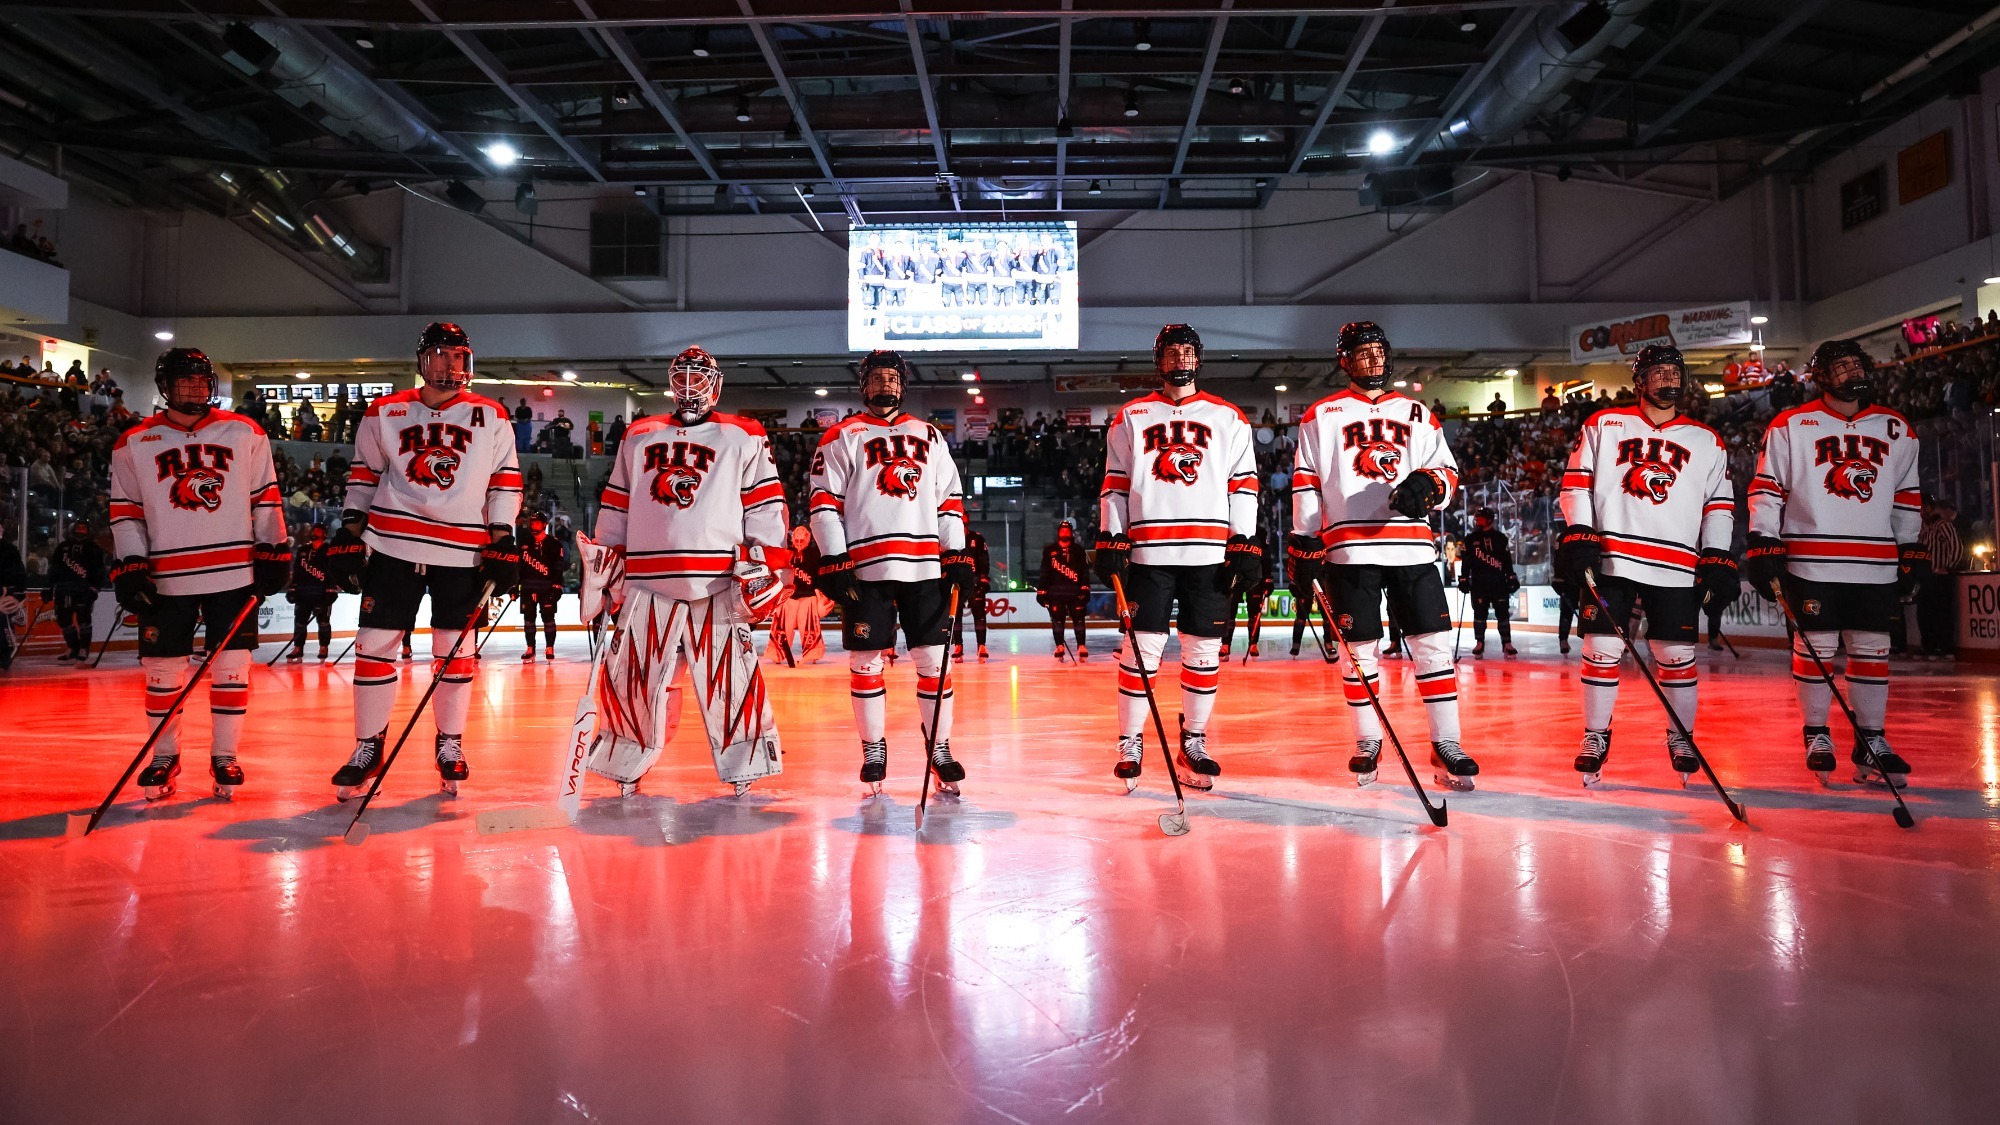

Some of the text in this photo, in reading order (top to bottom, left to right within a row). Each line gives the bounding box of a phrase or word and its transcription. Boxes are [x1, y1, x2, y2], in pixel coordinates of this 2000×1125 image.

[890, 315, 963, 334] CLASS
[470, 406, 485, 427] A
[1409, 402, 1423, 423] A
[399, 423, 473, 456] RIT
[925, 424, 939, 445] A
[1143, 420, 1212, 454] RIT
[1342, 418, 1411, 452] RIT
[1887, 418, 1901, 440] C
[155, 443, 234, 482] RIT
[643, 441, 716, 474] RIT
[864, 434, 930, 470] RIT
[1616, 437, 1692, 473] RIT
[1815, 434, 1890, 467] RIT
[301, 557, 325, 581] FALCONS
[523, 550, 549, 576] FALCONS
[1051, 556, 1079, 582] FALCONS
[1475, 547, 1503, 571] FALCONS
[790, 566, 812, 586] CONS
[1543, 598, 1560, 608] ADVANT
[1968, 584, 2000, 615] RO
[564, 730, 592, 797] VAPOR
